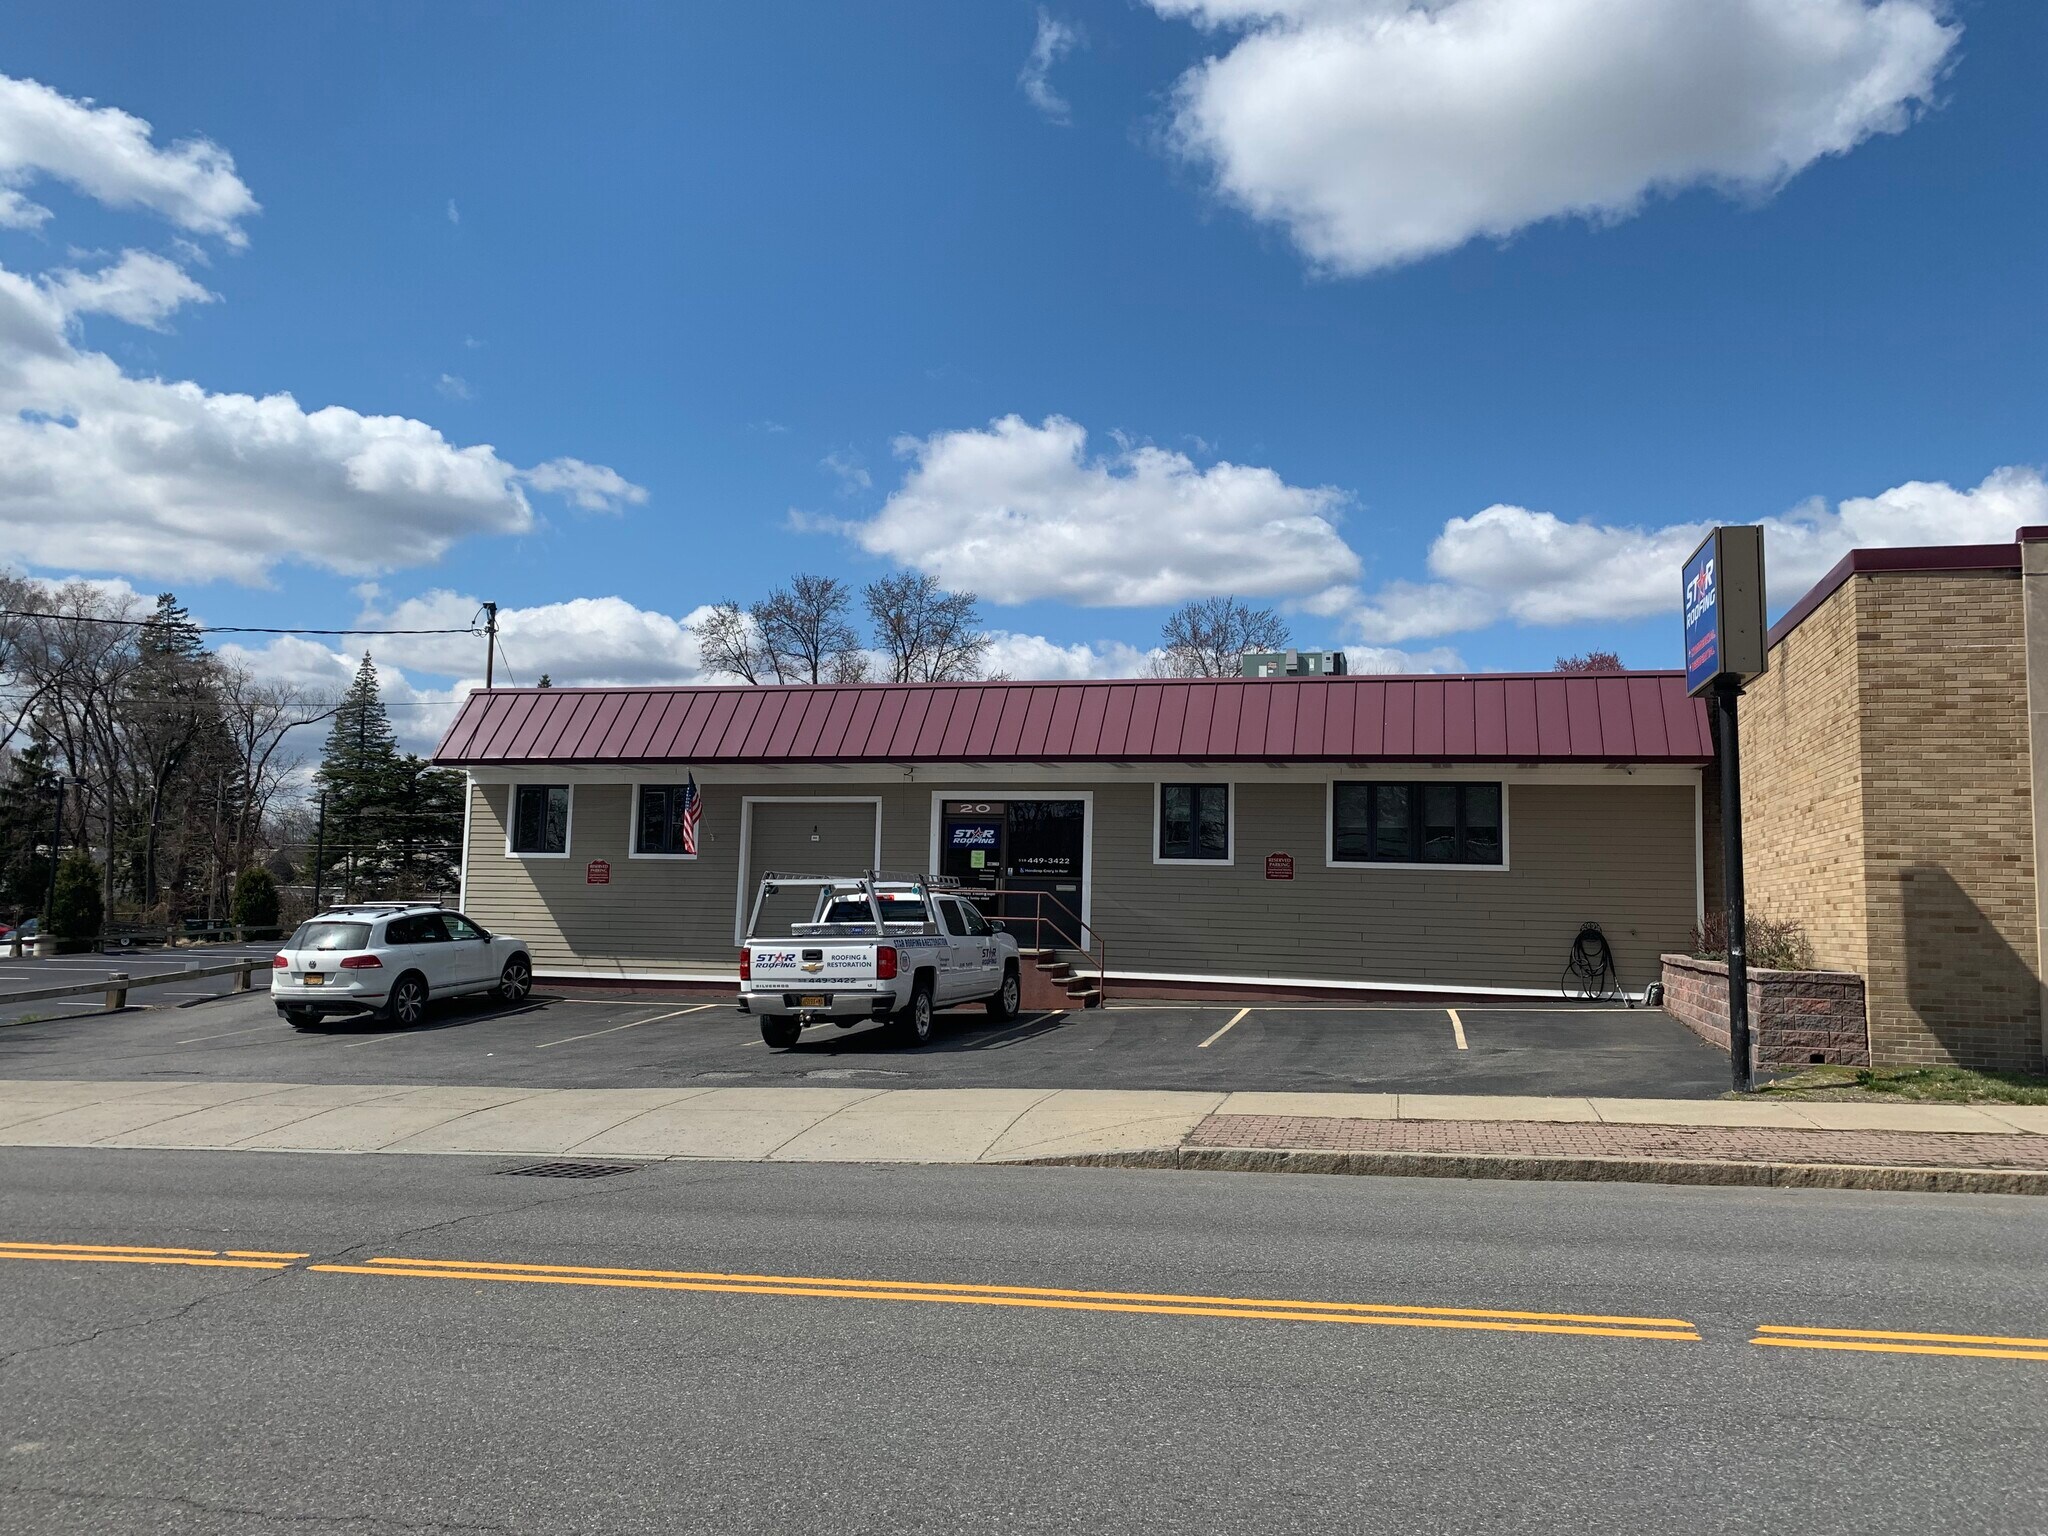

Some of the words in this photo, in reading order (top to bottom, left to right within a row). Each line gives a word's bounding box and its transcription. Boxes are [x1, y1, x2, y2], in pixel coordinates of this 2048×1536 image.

[1686, 559, 1714, 610] STAR
[1686, 587, 1716, 631] ROOFING
[960, 804, 990, 813] 20
[953, 827, 995, 838] STAR
[756, 952, 796, 962] STAR
